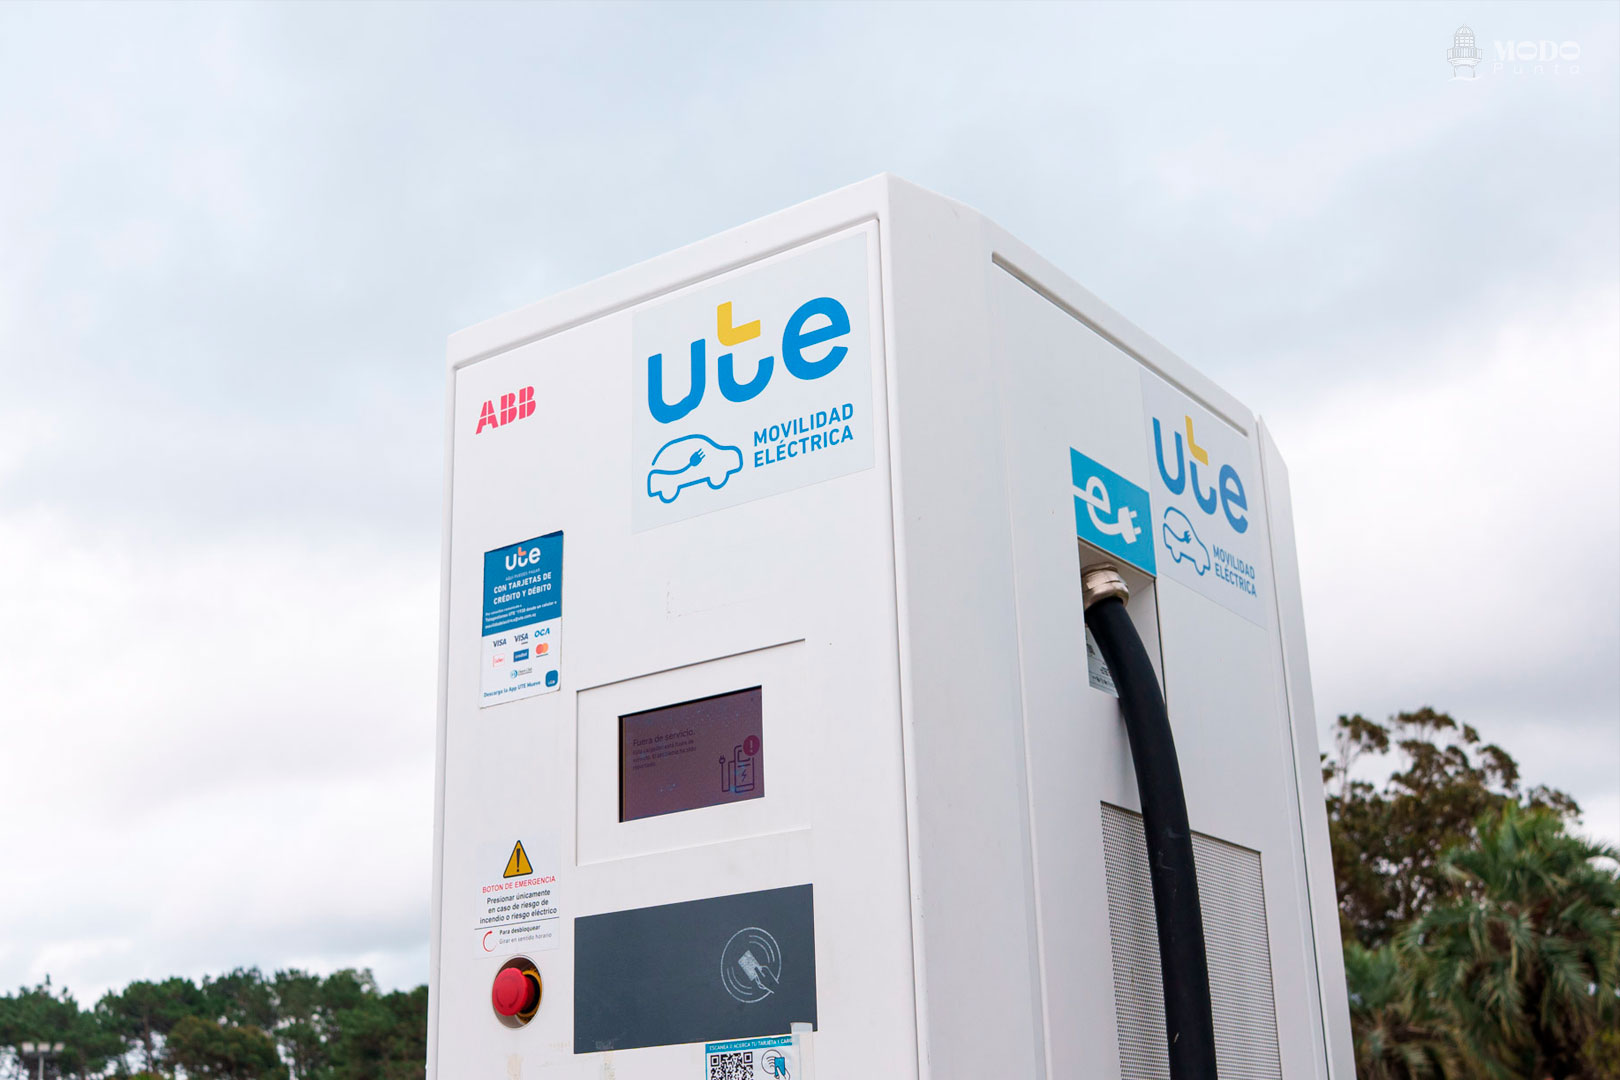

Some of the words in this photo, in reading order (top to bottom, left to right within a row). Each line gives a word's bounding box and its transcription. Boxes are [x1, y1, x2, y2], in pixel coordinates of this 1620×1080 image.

[648, 297, 851, 424] ute
[475, 386, 536, 434] ABB
[753, 403, 854, 447] MOVILIDAD
[753, 425, 854, 468] ELÉCTRICA
[1152, 415, 1248, 534] ute
[505, 546, 541, 571] ute
[1212, 544, 1256, 580] MOVILIDAD
[493, 584, 507, 594] CON
[508, 575, 542, 590] TARJETAS
[542, 572, 552, 581] DE
[1214, 562, 1257, 598] ELÉCTRICA
[493, 590, 521, 605] CRÉDITO
[522, 589, 527, 597] Y
[527, 583, 552, 596] DÉBITO
[493, 638, 507, 647] VISA
[514, 633, 529, 642] VISA
[534, 627, 550, 638] OCA
[482, 884, 503, 894] BOTON
[504, 882, 513, 890] DE
[514, 875, 556, 888] EMERGENCIA
[486, 895, 515, 904] Presionar
[515, 889, 551, 898] únicamente
[496, 904, 511, 913] caso
[512, 902, 519, 910] de
[520, 900, 540, 910] riesgo
[541, 898, 549, 906] de
[480, 914, 505, 924] incendio
[511, 910, 530, 920] riesgo
[531, 906, 558, 917] eléctrico
[511, 924, 541, 934] desbloquear
